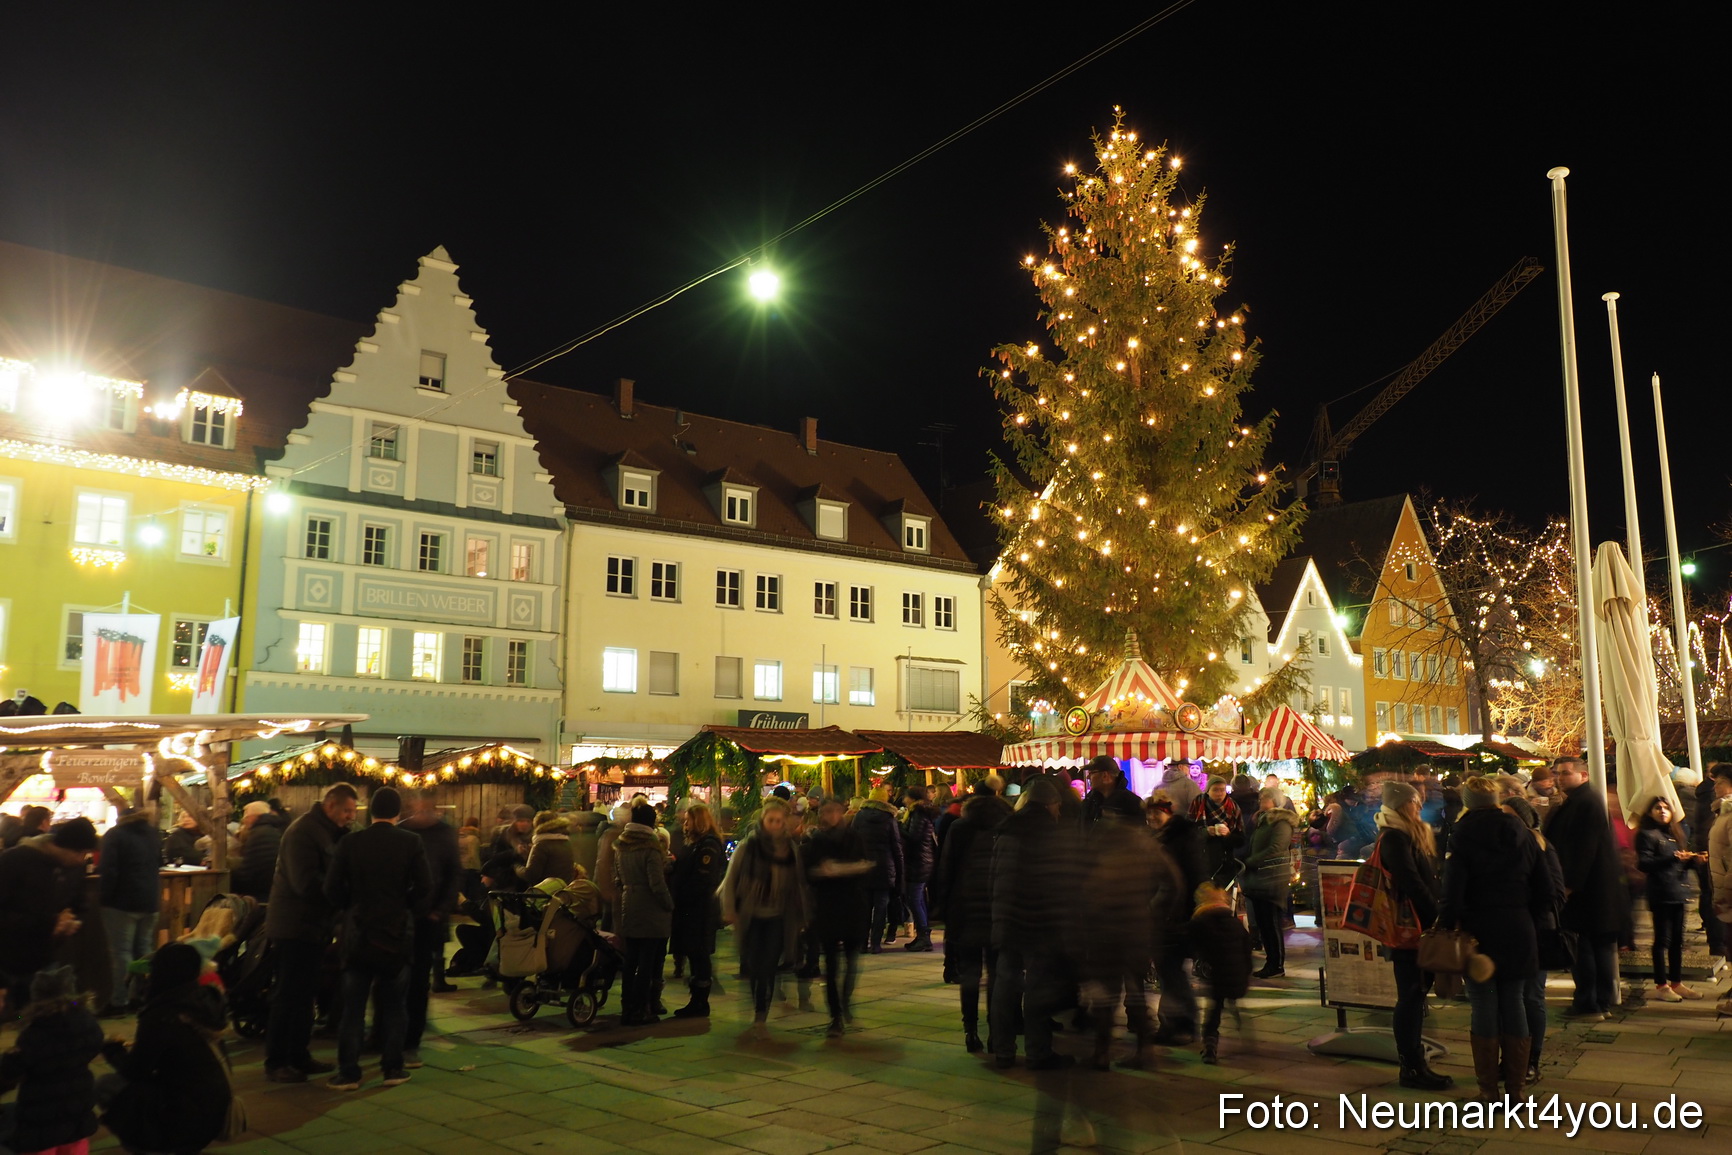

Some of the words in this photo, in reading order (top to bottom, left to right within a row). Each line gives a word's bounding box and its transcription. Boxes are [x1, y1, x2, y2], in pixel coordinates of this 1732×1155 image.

[366, 587, 429, 608] BRILLEN
[431, 594, 486, 614] WEBER
[55, 755, 138, 772] Feuerzangen
[77, 770, 116, 784] Bowle
